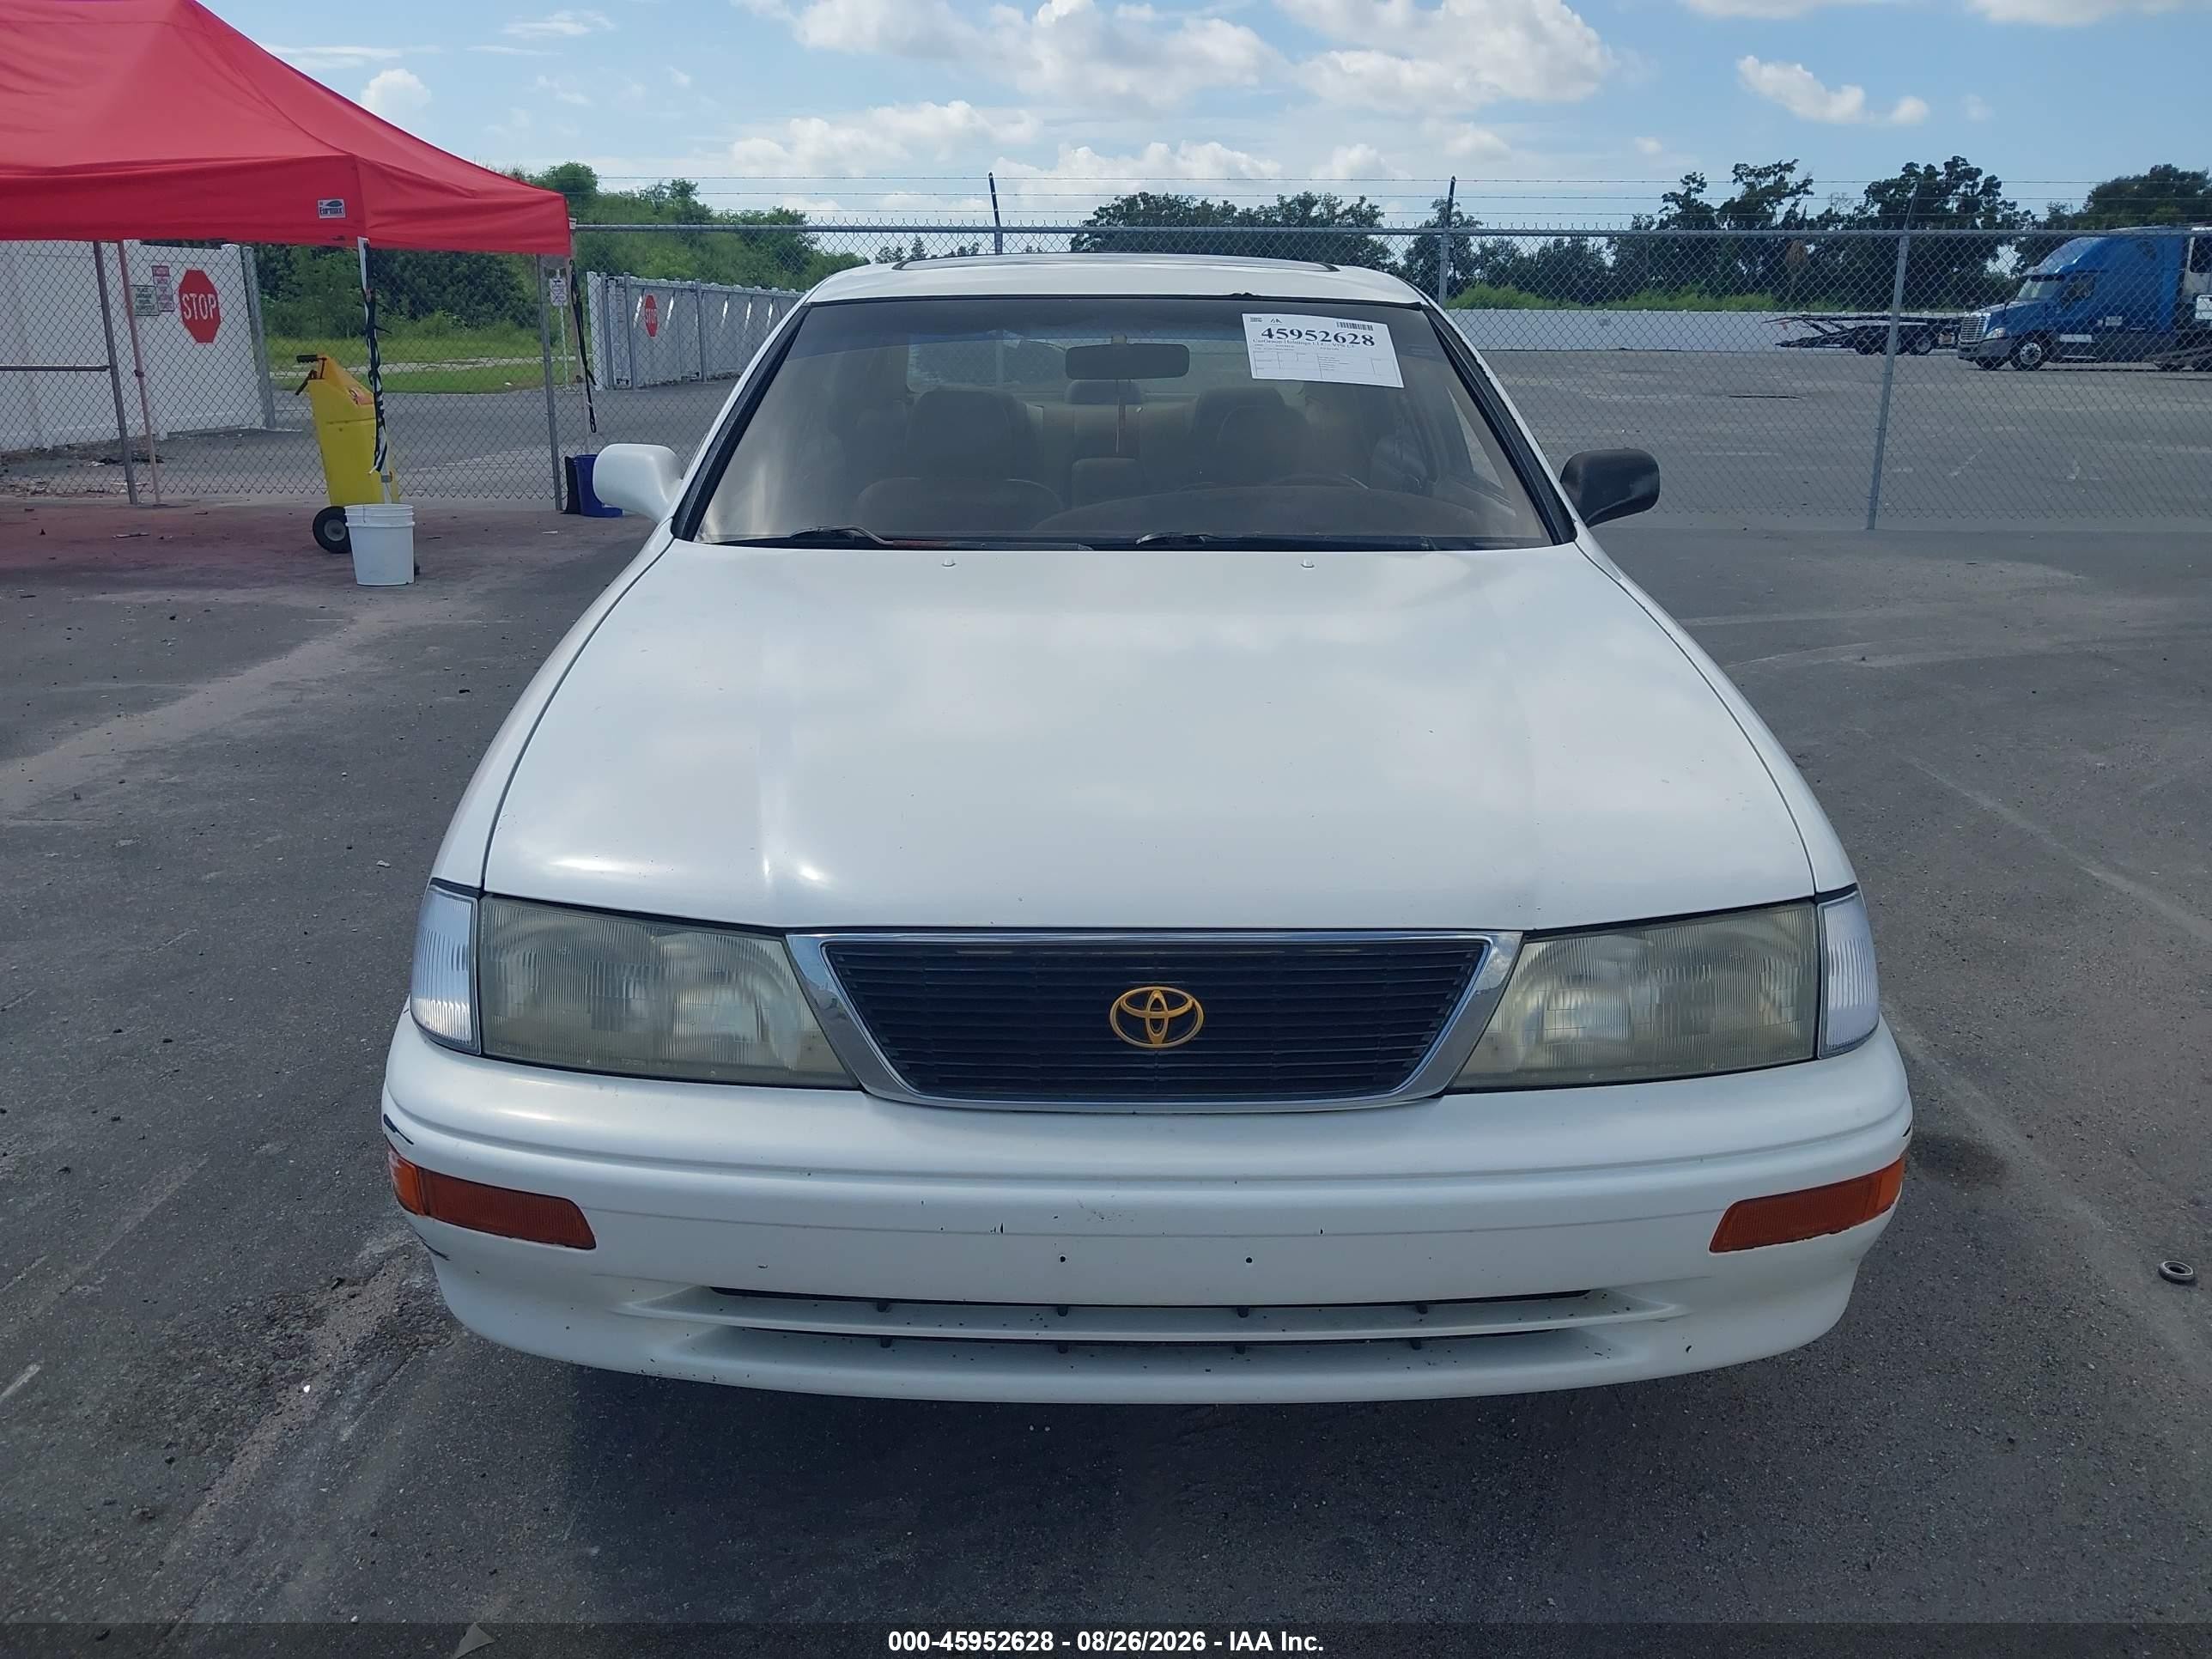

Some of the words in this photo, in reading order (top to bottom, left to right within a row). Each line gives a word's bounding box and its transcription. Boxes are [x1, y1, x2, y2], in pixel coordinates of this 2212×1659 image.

[182, 293, 216, 320] STOP
[645, 308, 657, 324] STOP
[1261, 327, 1375, 347] 45952628
